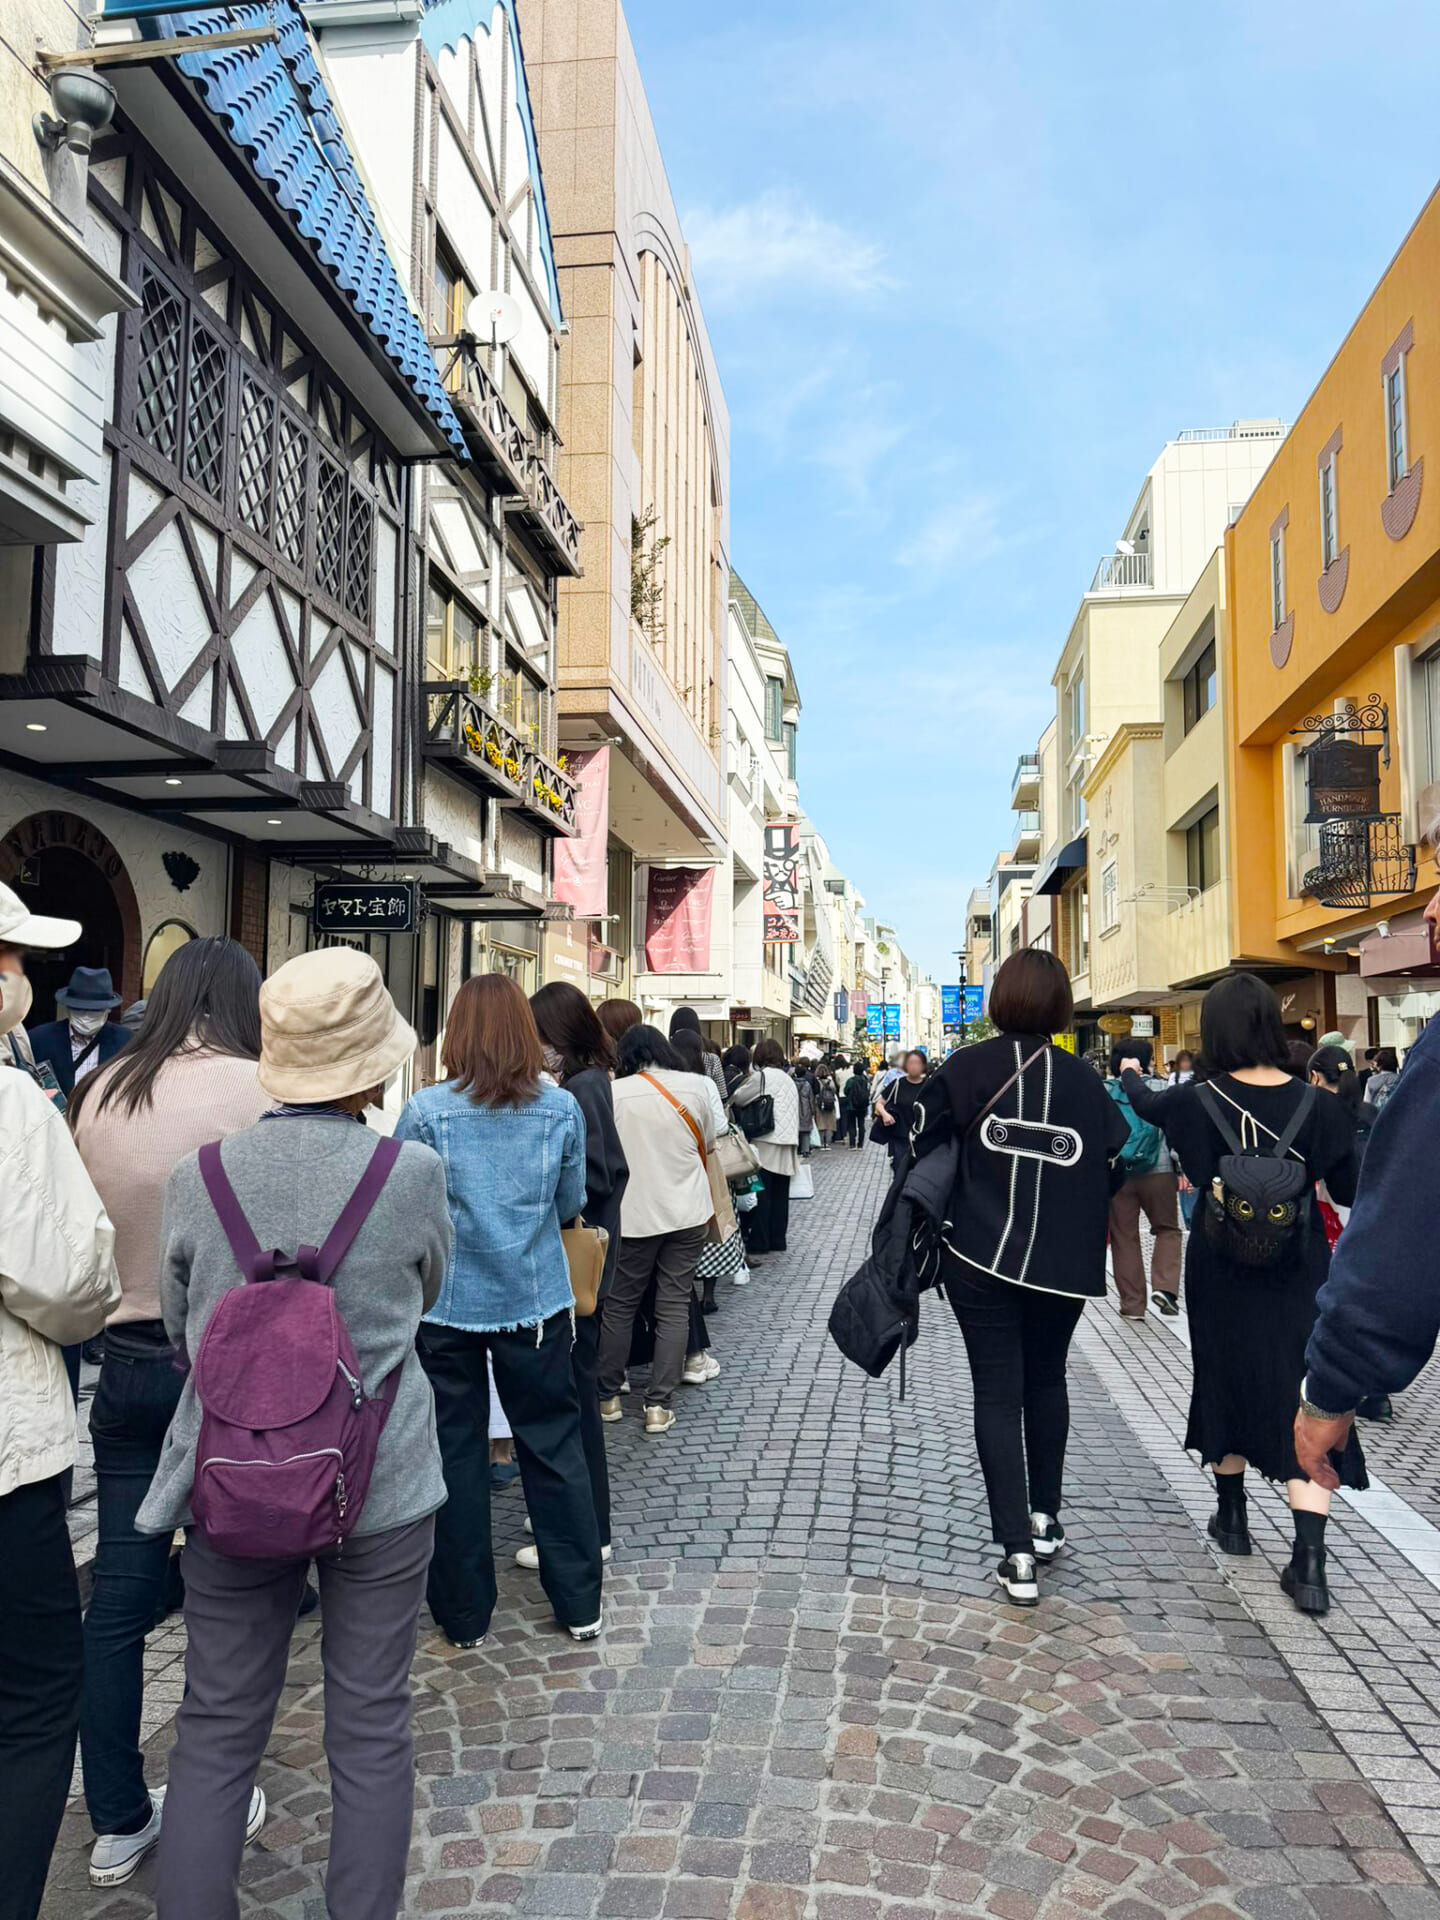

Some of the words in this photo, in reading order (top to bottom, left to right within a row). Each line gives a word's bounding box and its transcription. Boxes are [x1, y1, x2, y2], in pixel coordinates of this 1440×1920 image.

[321, 897, 406, 917] ヤマト宝飾
